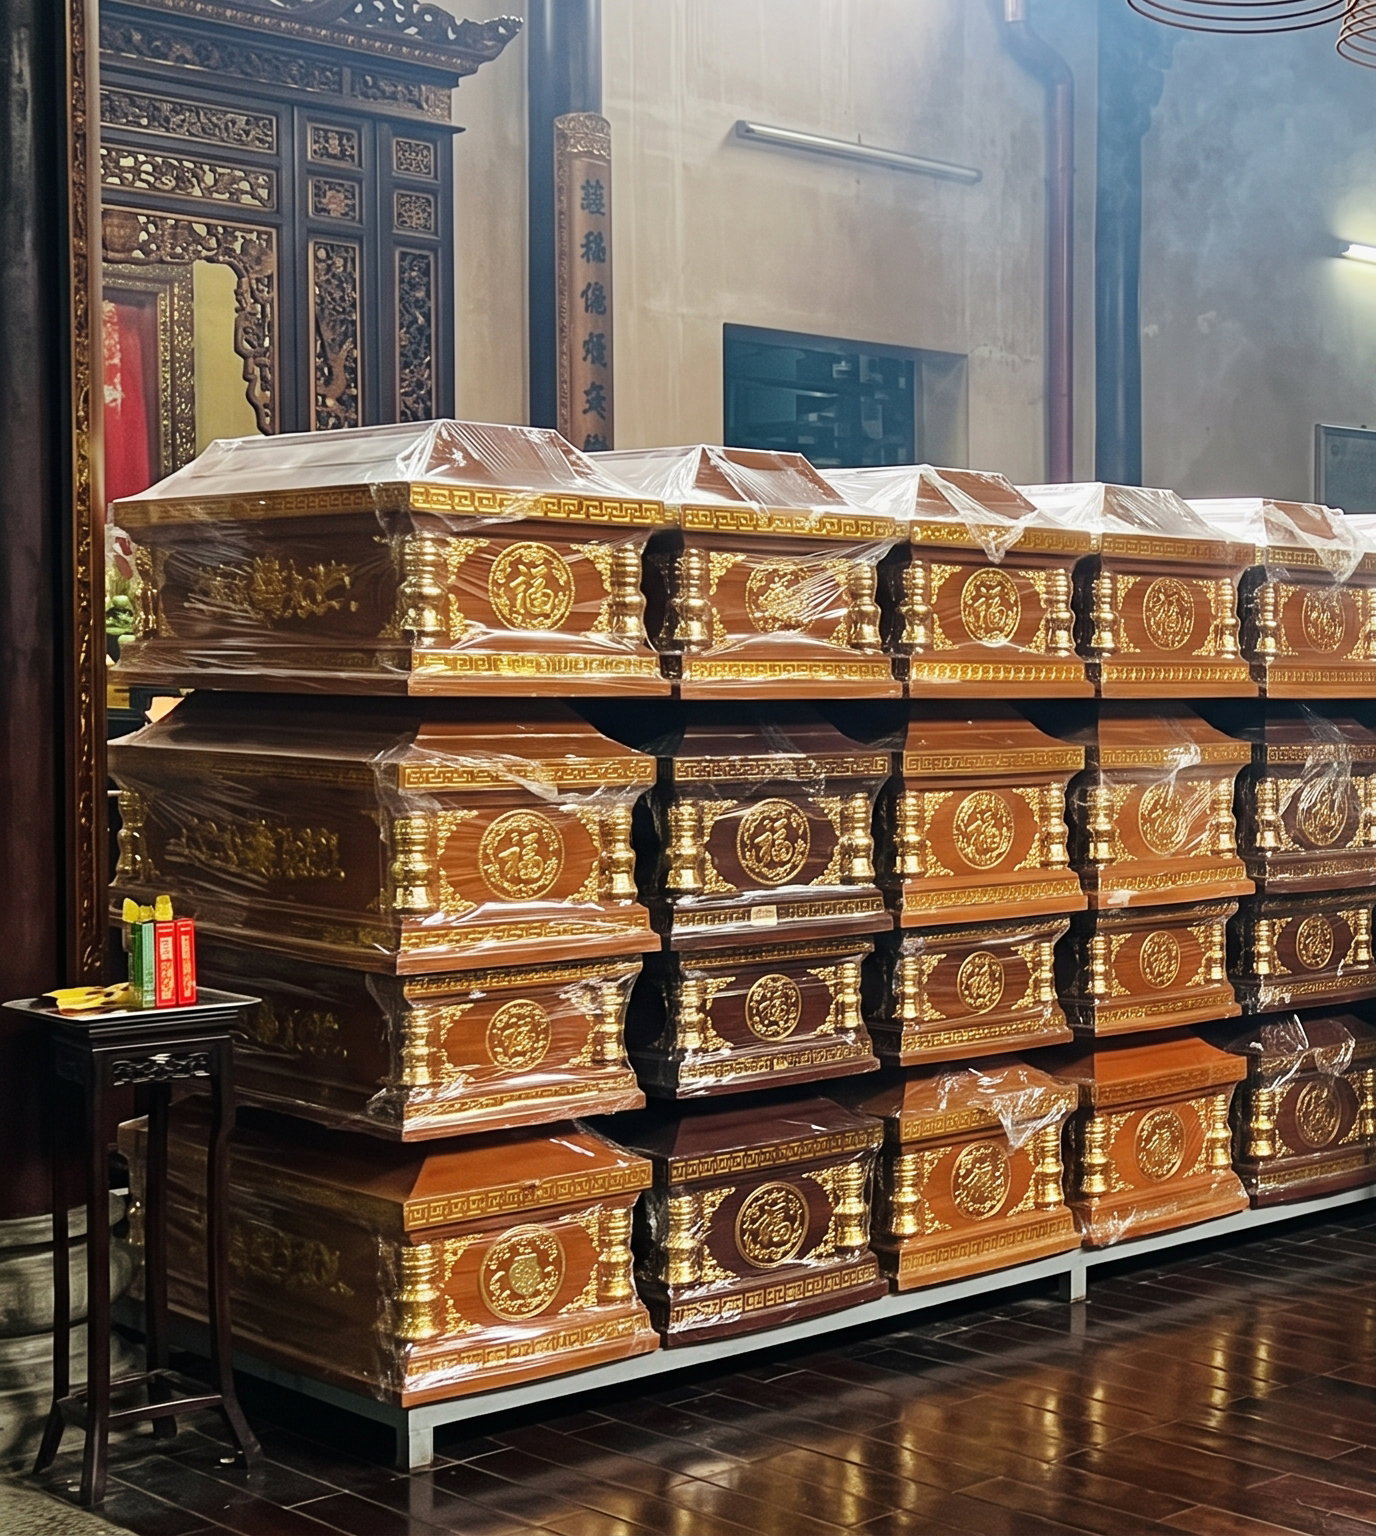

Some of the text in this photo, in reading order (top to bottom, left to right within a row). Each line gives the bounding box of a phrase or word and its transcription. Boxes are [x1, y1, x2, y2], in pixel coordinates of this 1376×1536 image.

[510, 564, 553, 614] 福
[968, 587, 1006, 628] 福
[499, 833, 542, 879] 福
[754, 818, 792, 863] 福
[753, 1202, 791, 1244] 福
